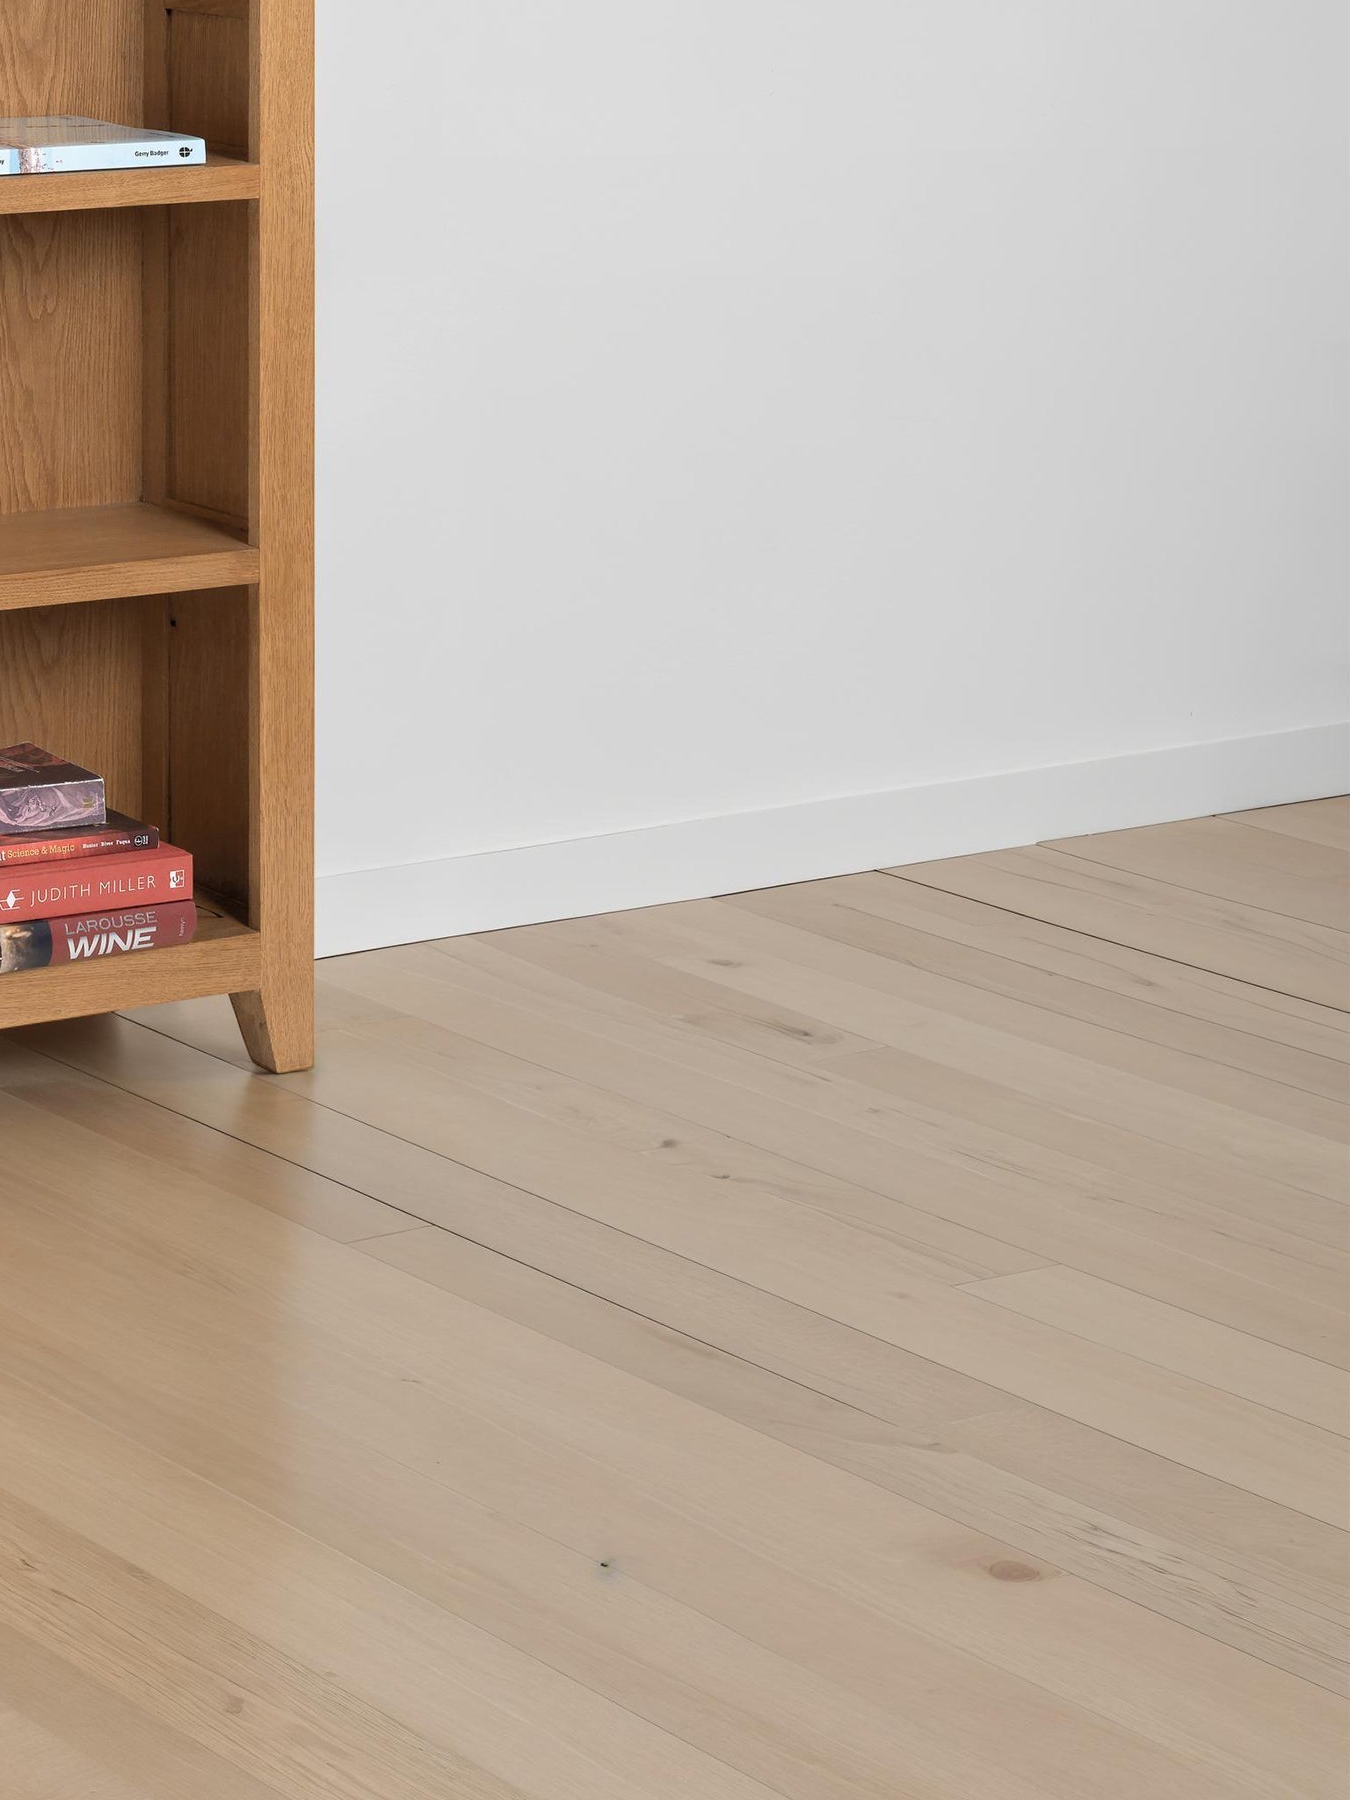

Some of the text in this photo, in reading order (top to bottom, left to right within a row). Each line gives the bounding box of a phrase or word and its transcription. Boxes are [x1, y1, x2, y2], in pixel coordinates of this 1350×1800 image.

[7, 845, 39, 859] Science
[41, 845, 48, 855] &
[49, 843, 75, 854] Magic
[30, 883, 91, 907] JUDITH
[99, 875, 156, 895] MILLER
[64, 911, 158, 936] LAROUSSE
[66, 926, 157, 960] WINE
